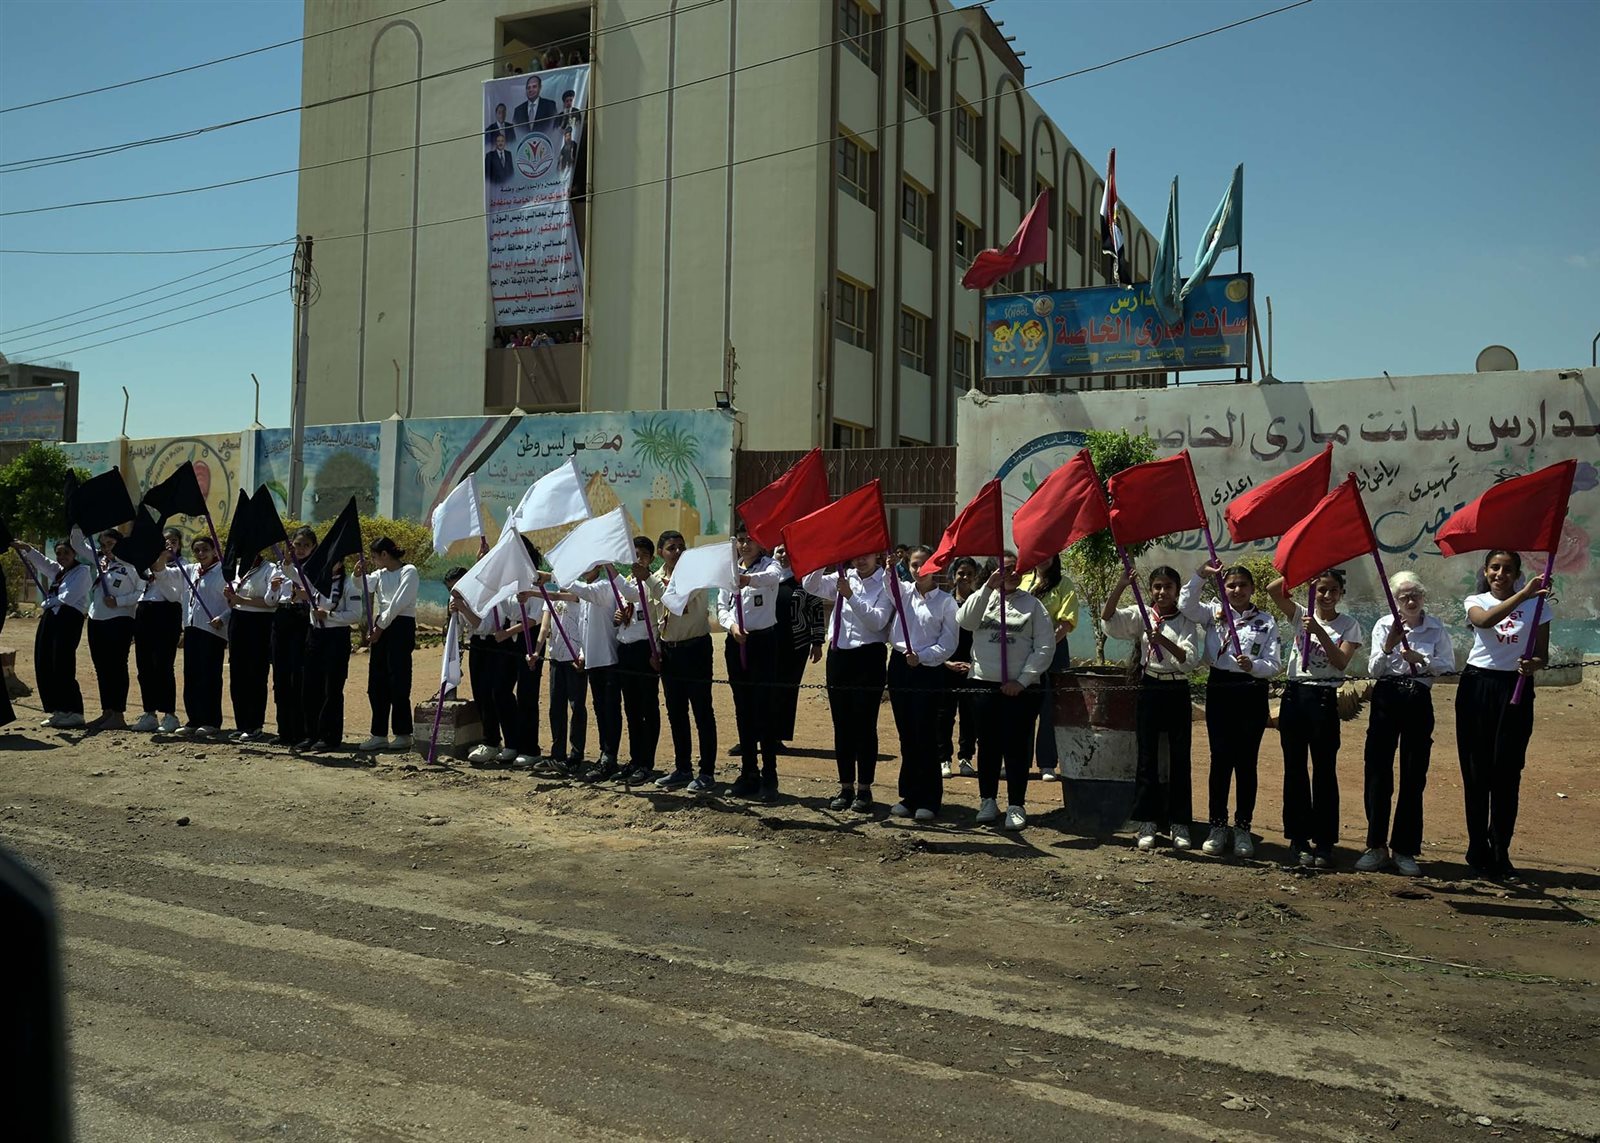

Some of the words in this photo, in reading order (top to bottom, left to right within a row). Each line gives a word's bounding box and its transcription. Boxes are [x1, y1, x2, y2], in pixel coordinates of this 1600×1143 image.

[1109, 288, 1154, 314] دارس
[1055, 315, 1132, 345] الخاصة
[1190, 306, 1248, 337] سانت
[1360, 405, 1460, 442] سانت
[567, 431, 623, 458] مصر
[1500, 620, 1515, 632] LA
